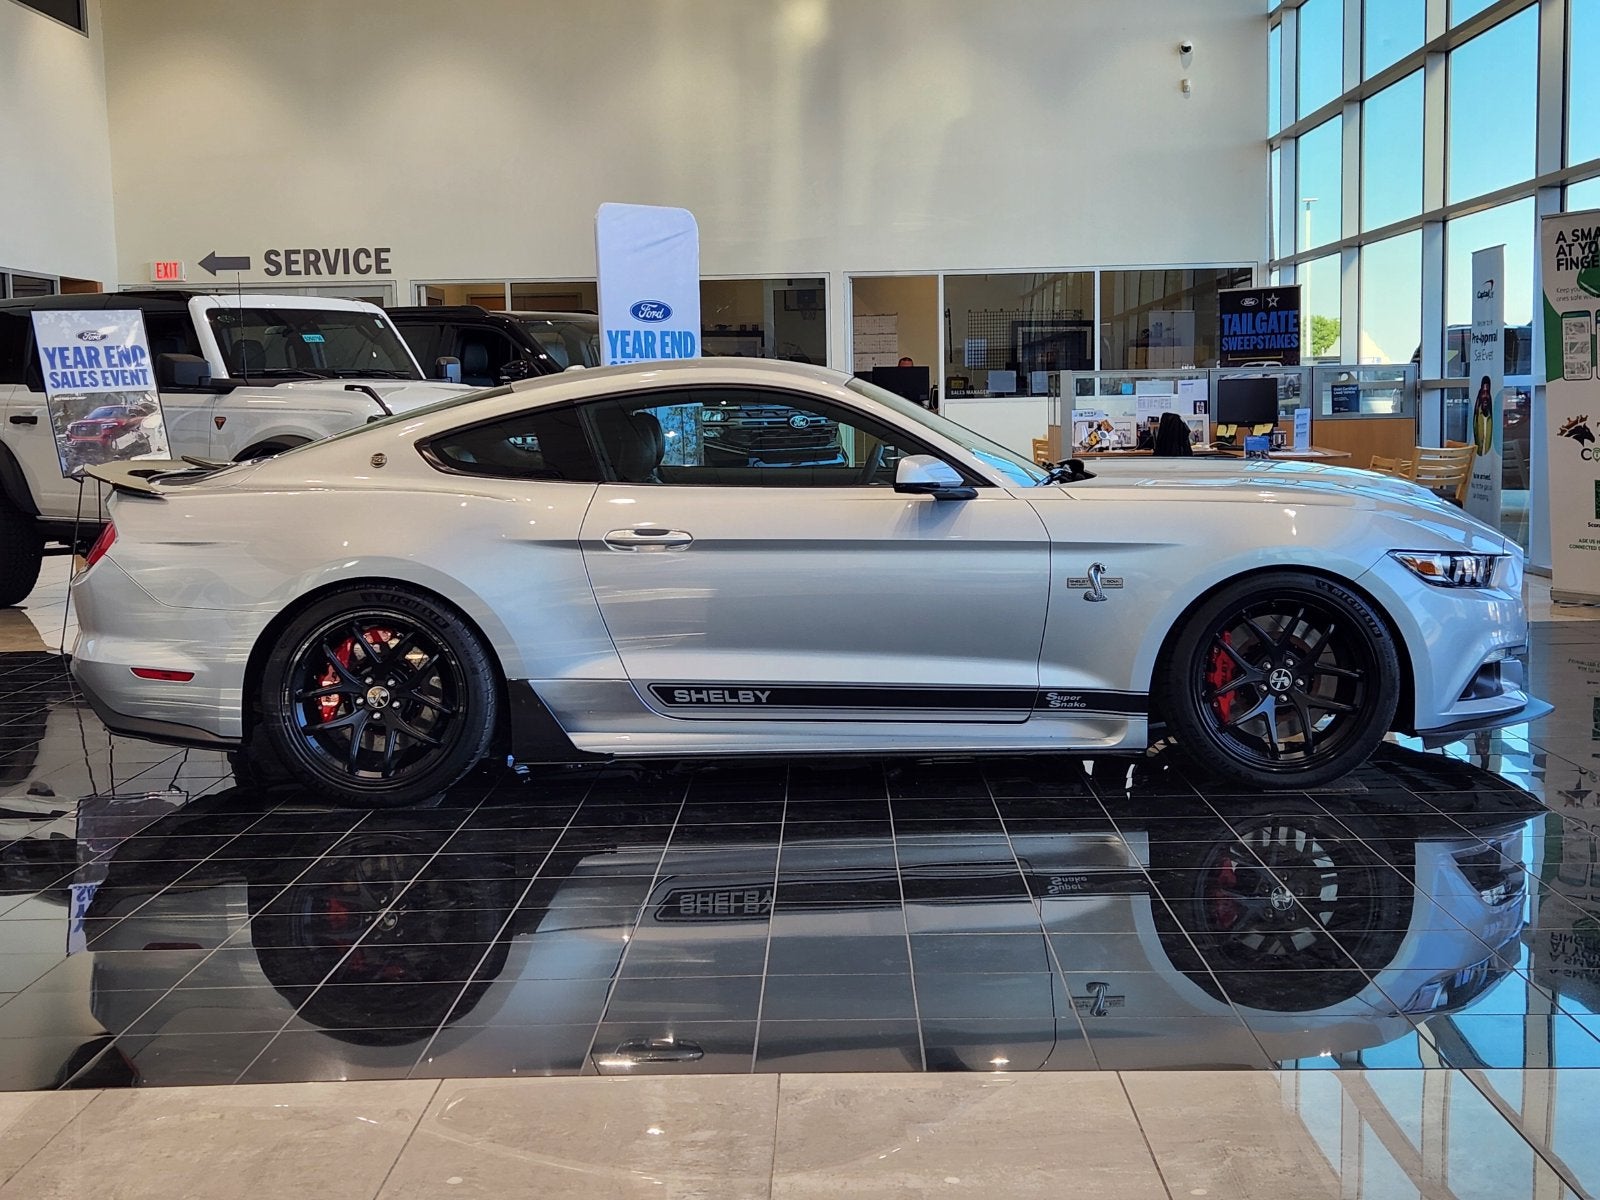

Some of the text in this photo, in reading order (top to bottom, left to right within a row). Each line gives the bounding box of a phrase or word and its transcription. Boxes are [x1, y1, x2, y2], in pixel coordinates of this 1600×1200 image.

[1555, 230, 1567, 244] A
[1556, 243, 1575, 258] AT
[155, 262, 179, 279] EXIT
[263, 247, 392, 277] SERVICE
[1222, 310, 1299, 336] TAILGATE
[607, 329, 696, 359] YEAR END
[1222, 333, 1299, 352] SWEEPSTAKES
[42, 344, 147, 370] YEAR END
[49, 368, 149, 389] SALES EVENT
[1331, 587, 1382, 636] MICHELIN
[673, 689, 772, 703] SHELBY
[1045, 692, 1082, 702] Super
[1048, 700, 1087, 708] Snake
